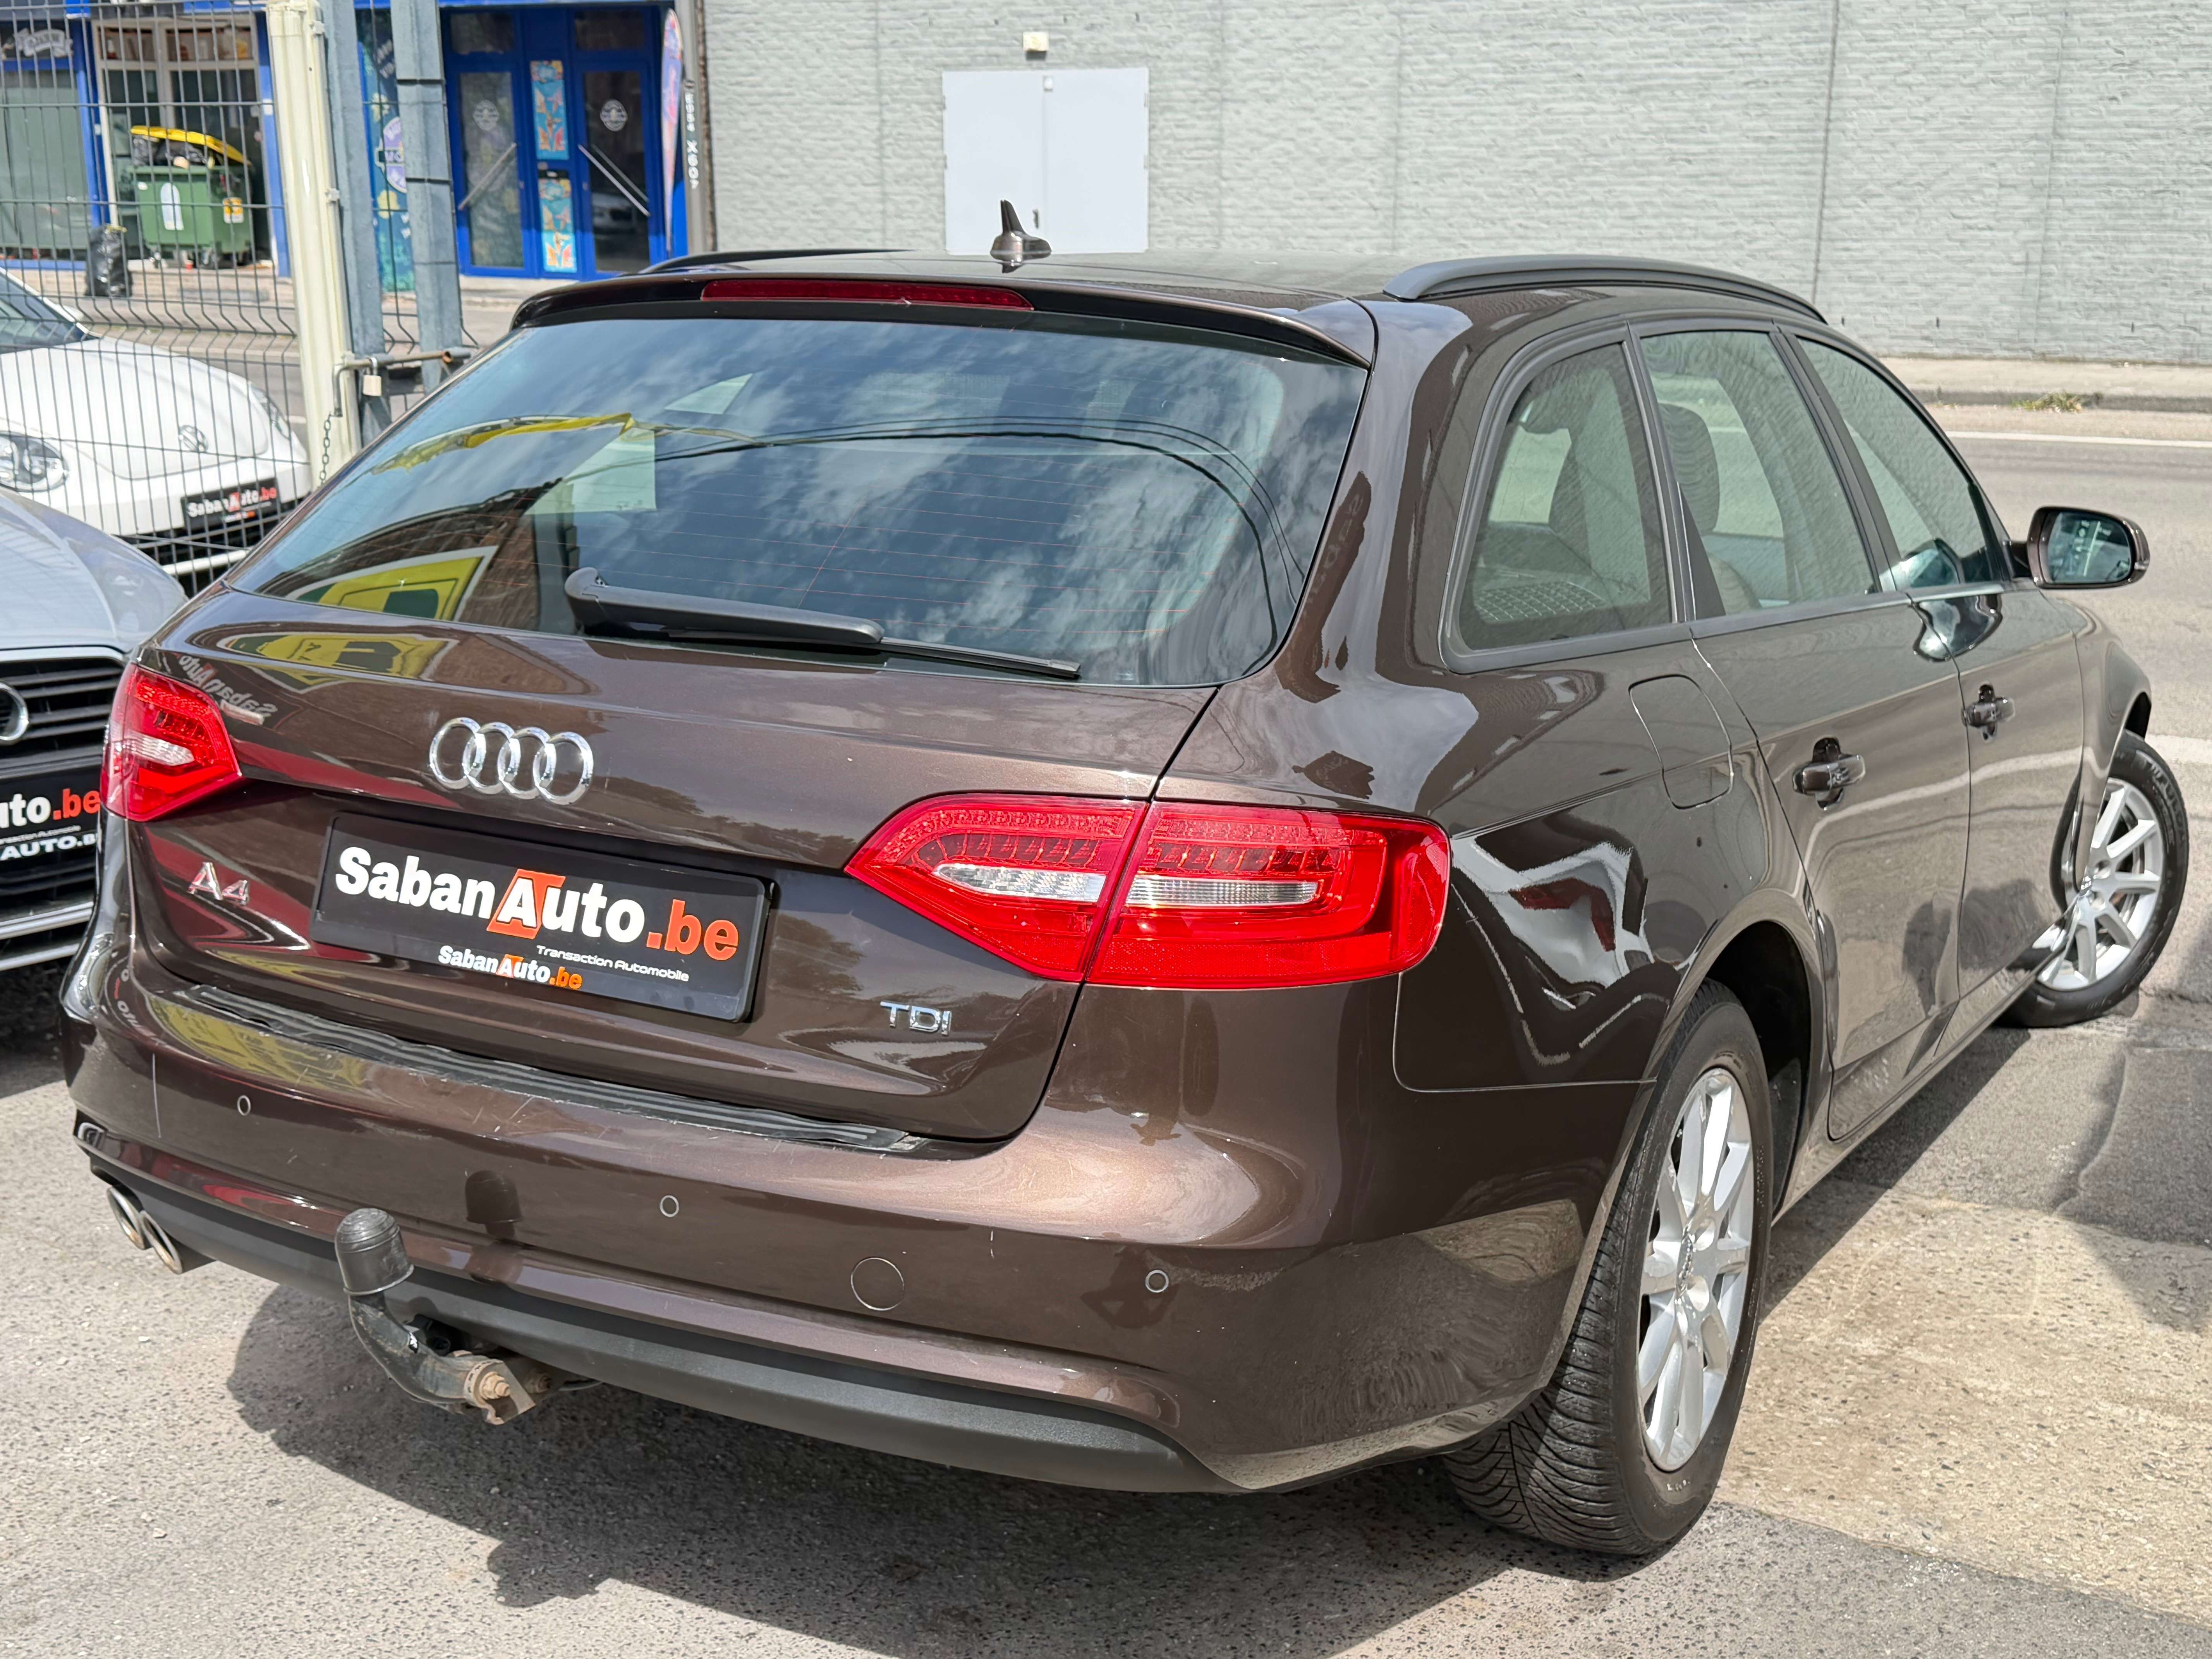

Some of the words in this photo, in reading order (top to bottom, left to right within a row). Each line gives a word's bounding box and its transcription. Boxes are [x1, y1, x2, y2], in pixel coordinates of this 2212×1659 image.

[187, 862, 250, 905] A4
[335, 847, 739, 960] SabanAuto.be
[438, 945, 583, 990] SabanAuto.be
[537, 945, 613, 968] Transaction
[614, 960, 689, 982] Automobile
[880, 1001, 951, 1032] TDI
